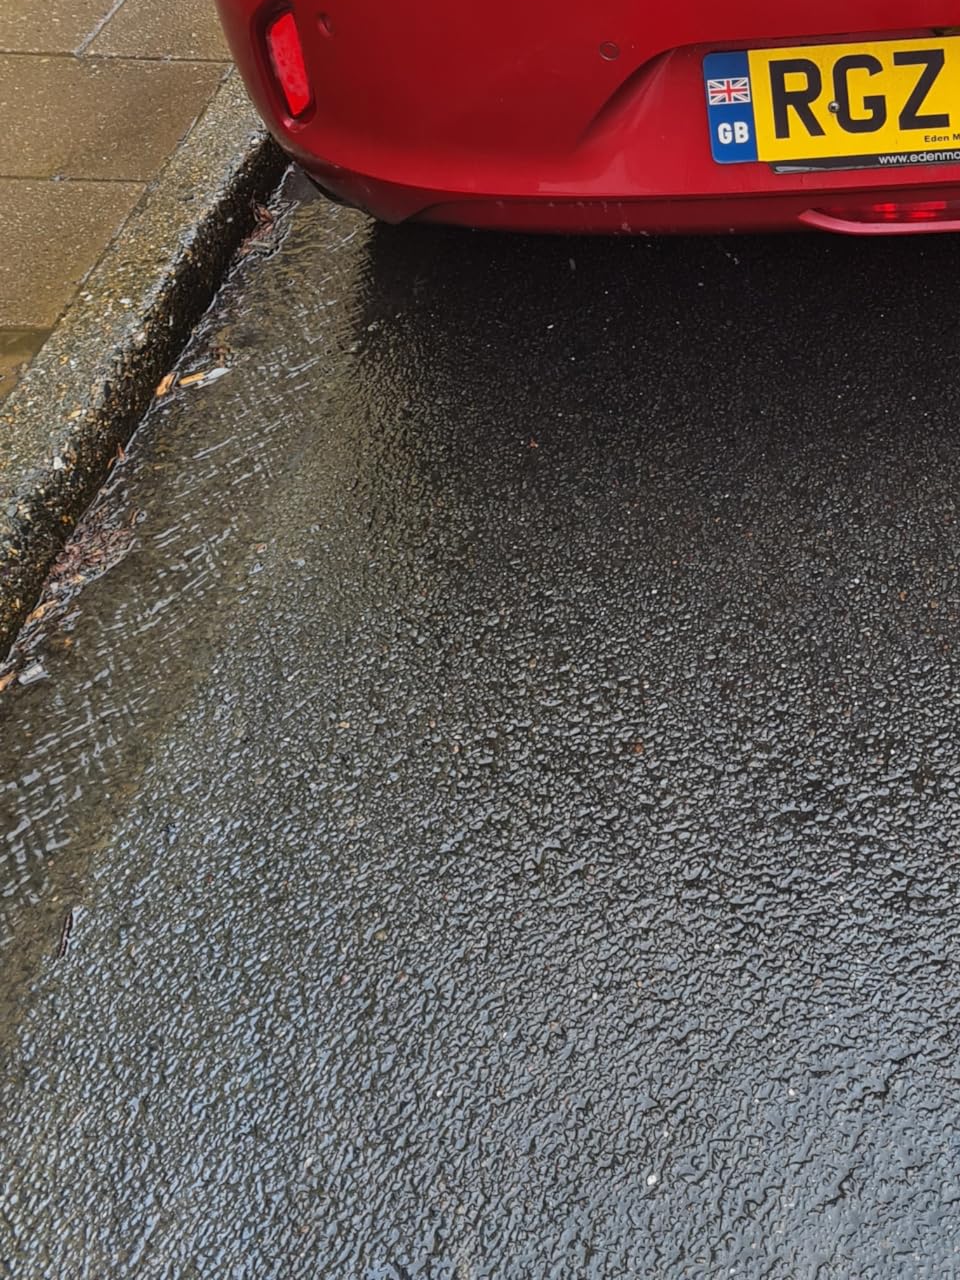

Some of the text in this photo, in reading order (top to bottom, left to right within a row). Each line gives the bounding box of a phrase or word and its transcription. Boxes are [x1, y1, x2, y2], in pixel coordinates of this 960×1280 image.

[768, 48, 950, 139] RGZ
[717, 121, 749, 145] GB
[924, 135, 950, 143] Eden
